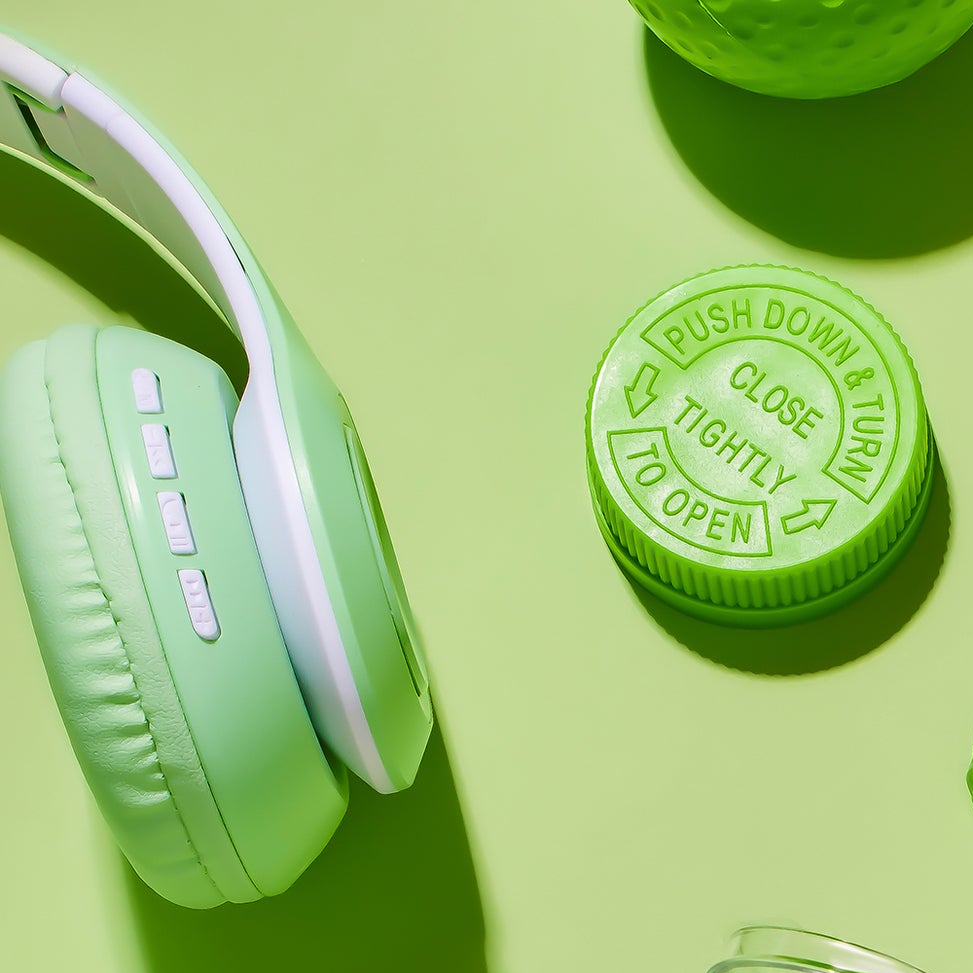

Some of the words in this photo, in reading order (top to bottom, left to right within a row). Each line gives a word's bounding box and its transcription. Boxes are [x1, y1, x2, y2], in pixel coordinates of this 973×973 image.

[663, 299, 752, 355] PUSH
[763, 299, 861, 367] DOWN
[729, 361, 824, 439] CLOSE
[844, 367, 875, 391] &
[672, 395, 797, 495] TIGHTLY
[838, 393, 885, 484] TURN
[626, 442, 667, 486] TO
[662, 490, 752, 544] OPEN
